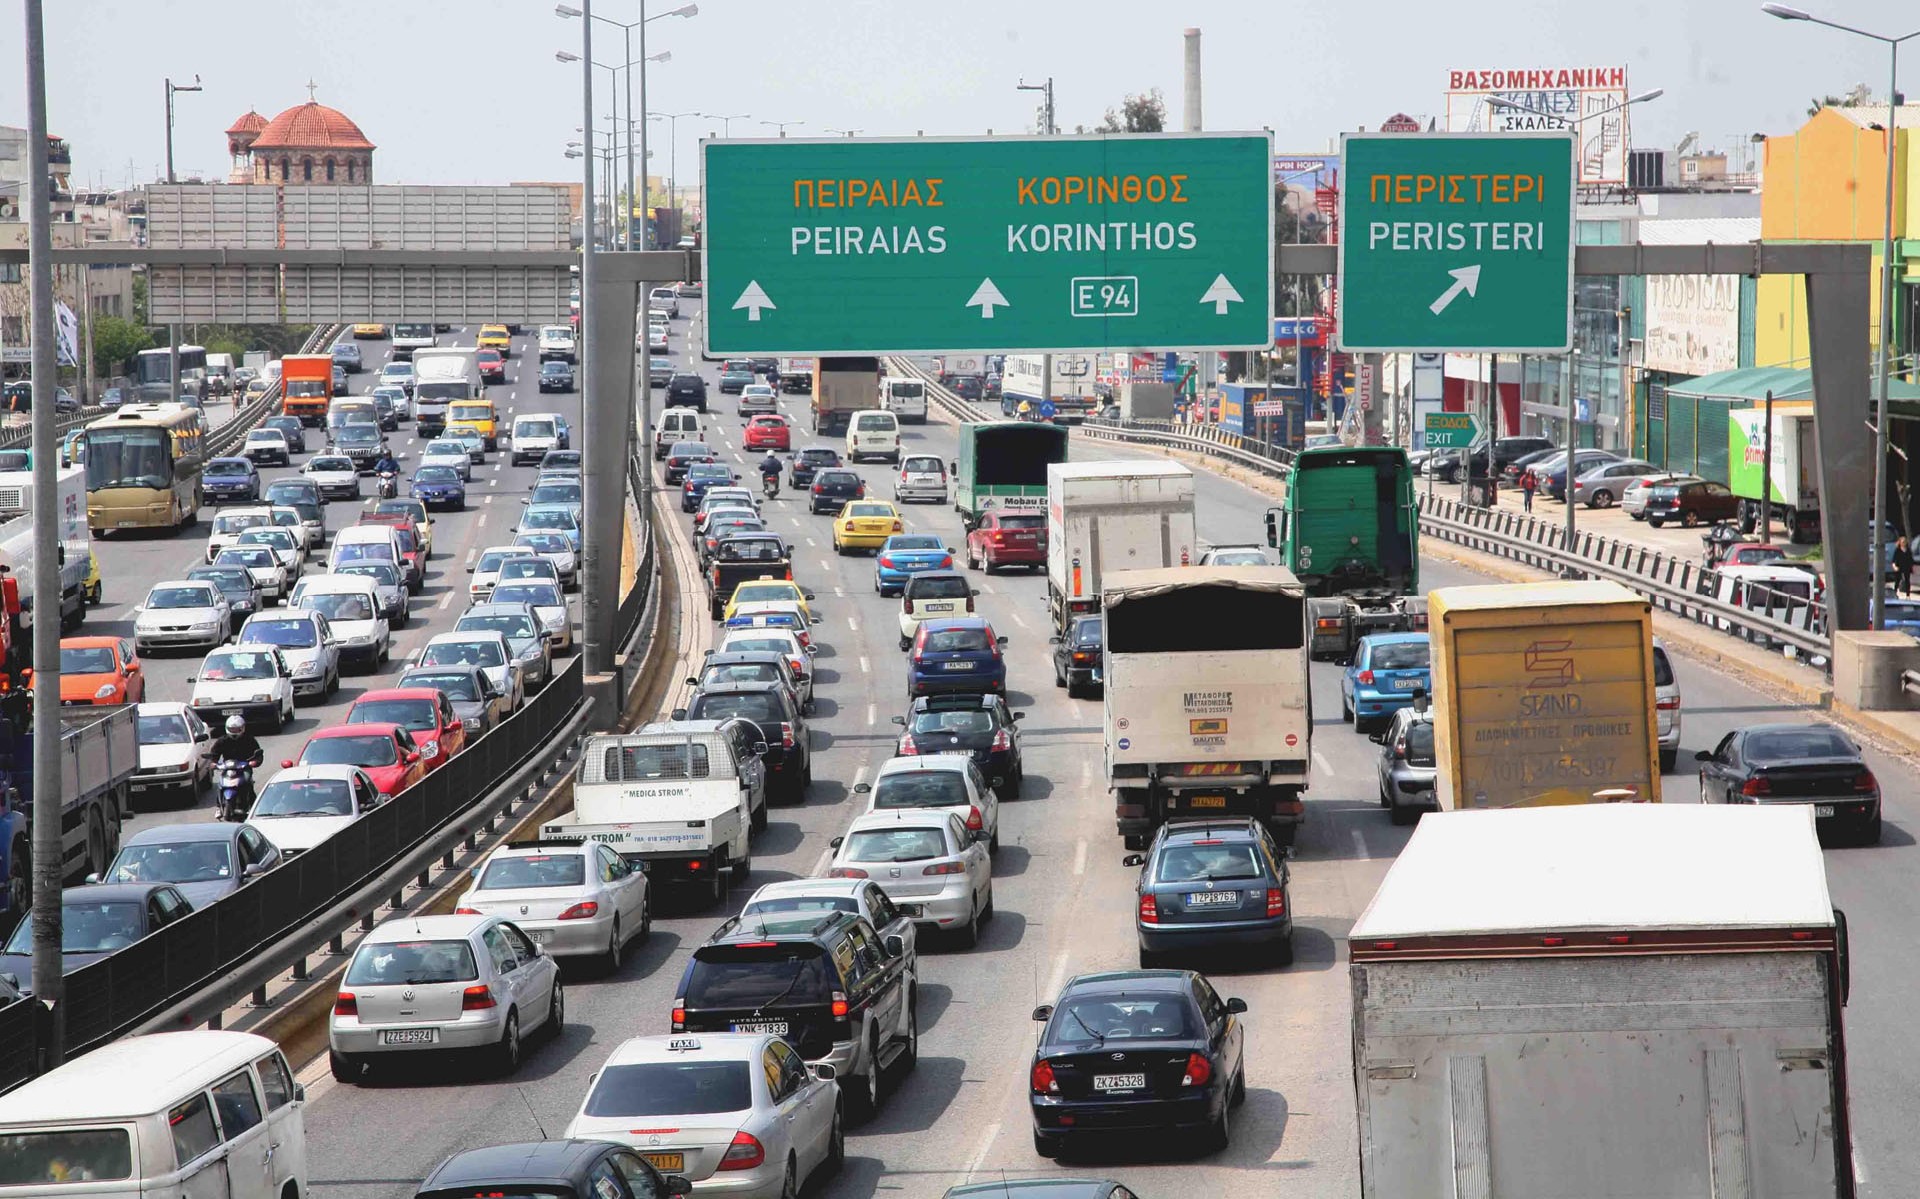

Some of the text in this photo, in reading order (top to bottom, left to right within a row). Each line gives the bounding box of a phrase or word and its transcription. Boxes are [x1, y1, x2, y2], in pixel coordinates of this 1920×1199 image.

[1450, 68, 1624, 90] ΒΑΣΟΜΗΧΑΝΙΚΗ
[1506, 116, 1566, 130] ΣΚΑΛΕΣ
[792, 178, 945, 208] ΠΕΙΡΑΙΑΣ
[1017, 173, 1190, 205] ΚΟΡΙΝΘΟΣ
[1370, 174, 1544, 203] ΠΕΡΙΣΤΕΡΙ
[791, 225, 948, 255] PEIRAIAS
[1007, 221, 1198, 253] KORINTHOS
[1369, 220, 1544, 251] PERISTERI
[1078, 284, 1131, 309] E 94
[1361, 365, 1370, 410] OUTLET
[1427, 416, 1470, 428] ΕΞΟΔΟΣ
[1426, 432, 1453, 444] EXIT
[1004, 497, 1037, 505] Mobau
[1519, 693, 1582, 717] STAND
[670, 1039, 695, 1048] TAXI
